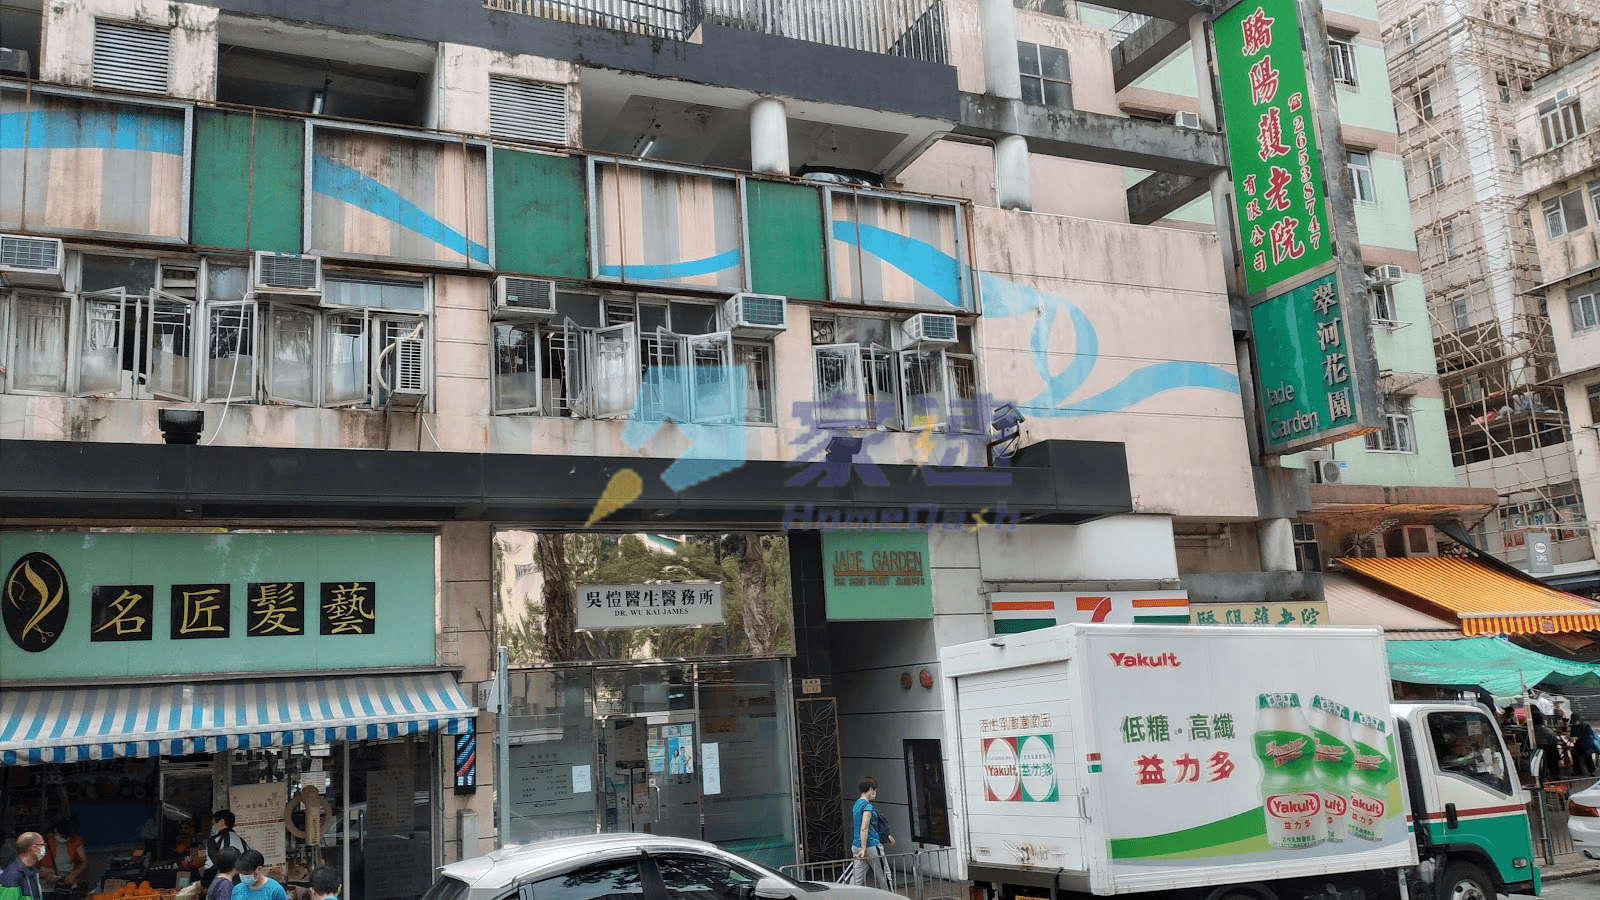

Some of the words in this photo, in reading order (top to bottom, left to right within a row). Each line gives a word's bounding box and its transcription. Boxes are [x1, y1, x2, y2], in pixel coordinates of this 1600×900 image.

[1241, 6, 1305, 265] 驕陽護老院
[1292, 114, 1321, 250] 26538747
[1243, 174, 1267, 272] 有限公司
[1312, 282, 1352, 422] 翠河花園
[1266, 381, 1295, 412] Jade
[1269, 410, 1320, 439] Garden
[833, 550, 864, 572] JADE
[872, 550, 923, 572] GARDEN
[585, 588, 714, 608] 吳愷醫生醫務所
[94, 581, 376, 637] 名匠髮藝
[614, 609, 628, 617] DR.
[662, 608, 689, 616] JAMES
[1108, 653, 1181, 668] Yakult
[984, 764, 1018, 777] Yakult
[1134, 750, 1235, 785] 益力多
[1273, 799, 1317, 813] Yakult
[1324, 800, 1343, 813] ult
[1351, 796, 1381, 814] akult
[1284, 820, 1311, 830] 益力多
[1351, 813, 1374, 826] 益力多
